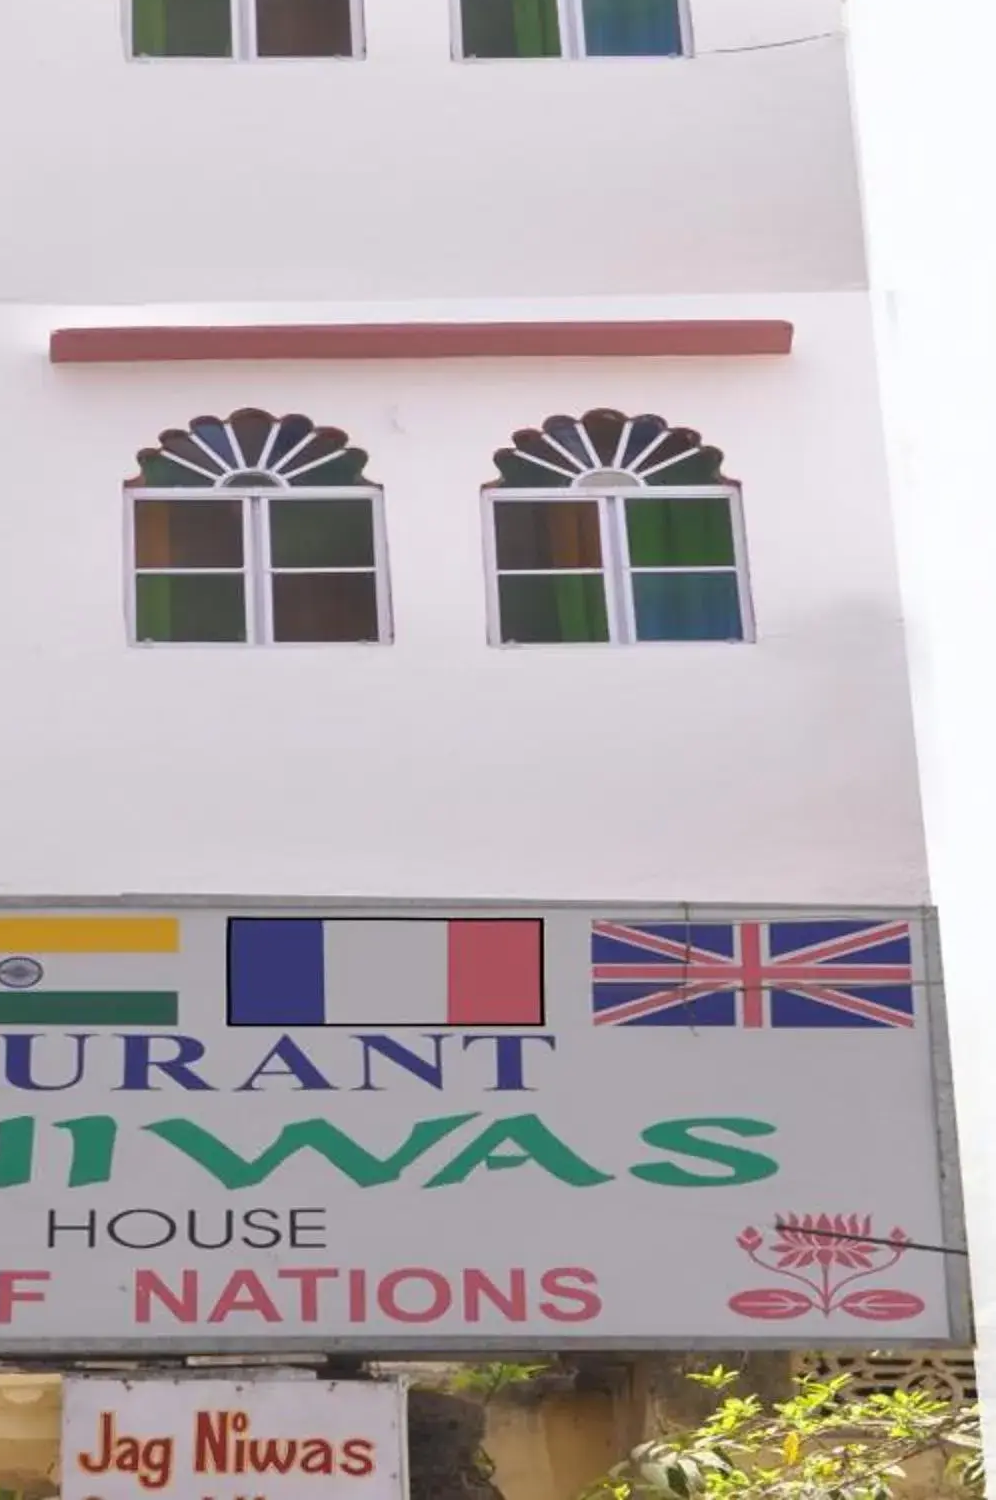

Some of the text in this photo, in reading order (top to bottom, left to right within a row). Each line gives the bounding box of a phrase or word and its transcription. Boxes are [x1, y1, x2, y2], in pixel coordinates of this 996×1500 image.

[47, 1208, 328, 1250] HOUSE
[134, 1267, 604, 1323] NATIONS
[78, 1410, 375, 1490] Jag Niwas
